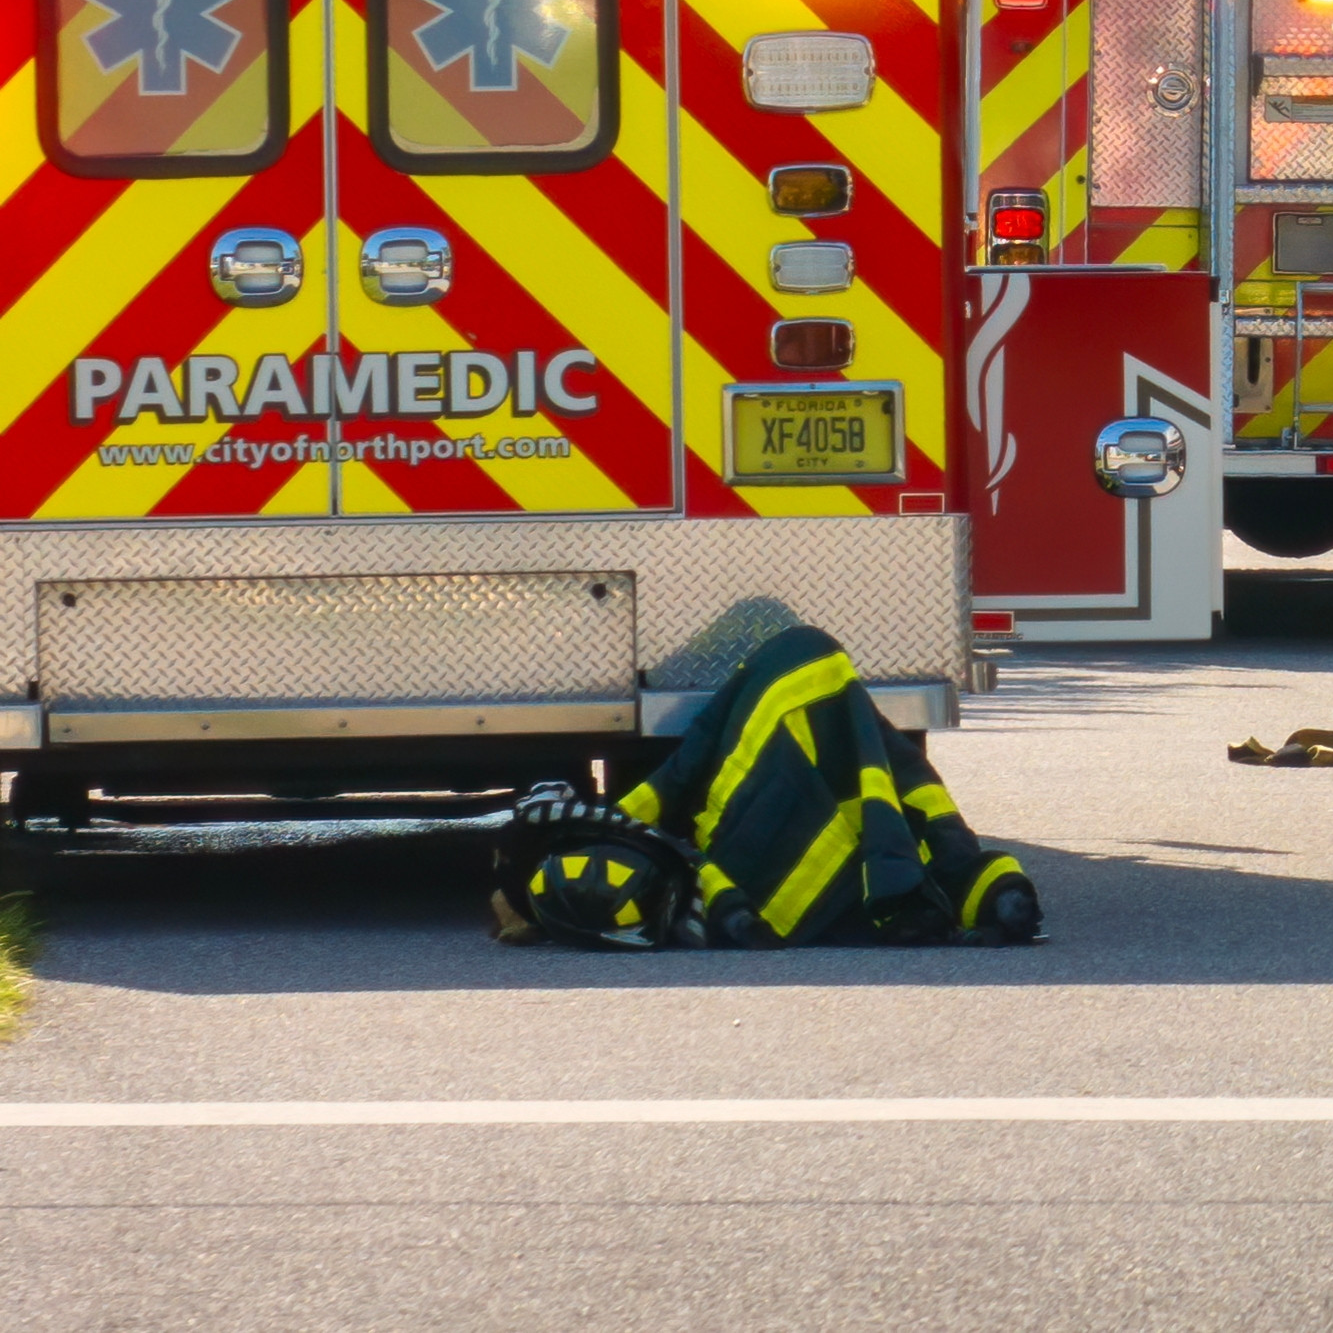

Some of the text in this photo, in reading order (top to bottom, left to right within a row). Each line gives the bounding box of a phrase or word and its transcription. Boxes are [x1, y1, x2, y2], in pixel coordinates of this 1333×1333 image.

[70, 349, 598, 425] PARAMEDIC
[776, 400, 847, 411] FLORIDA
[99, 433, 570, 470] www.cityofnorthport.com
[796, 458, 829, 468] CITY
